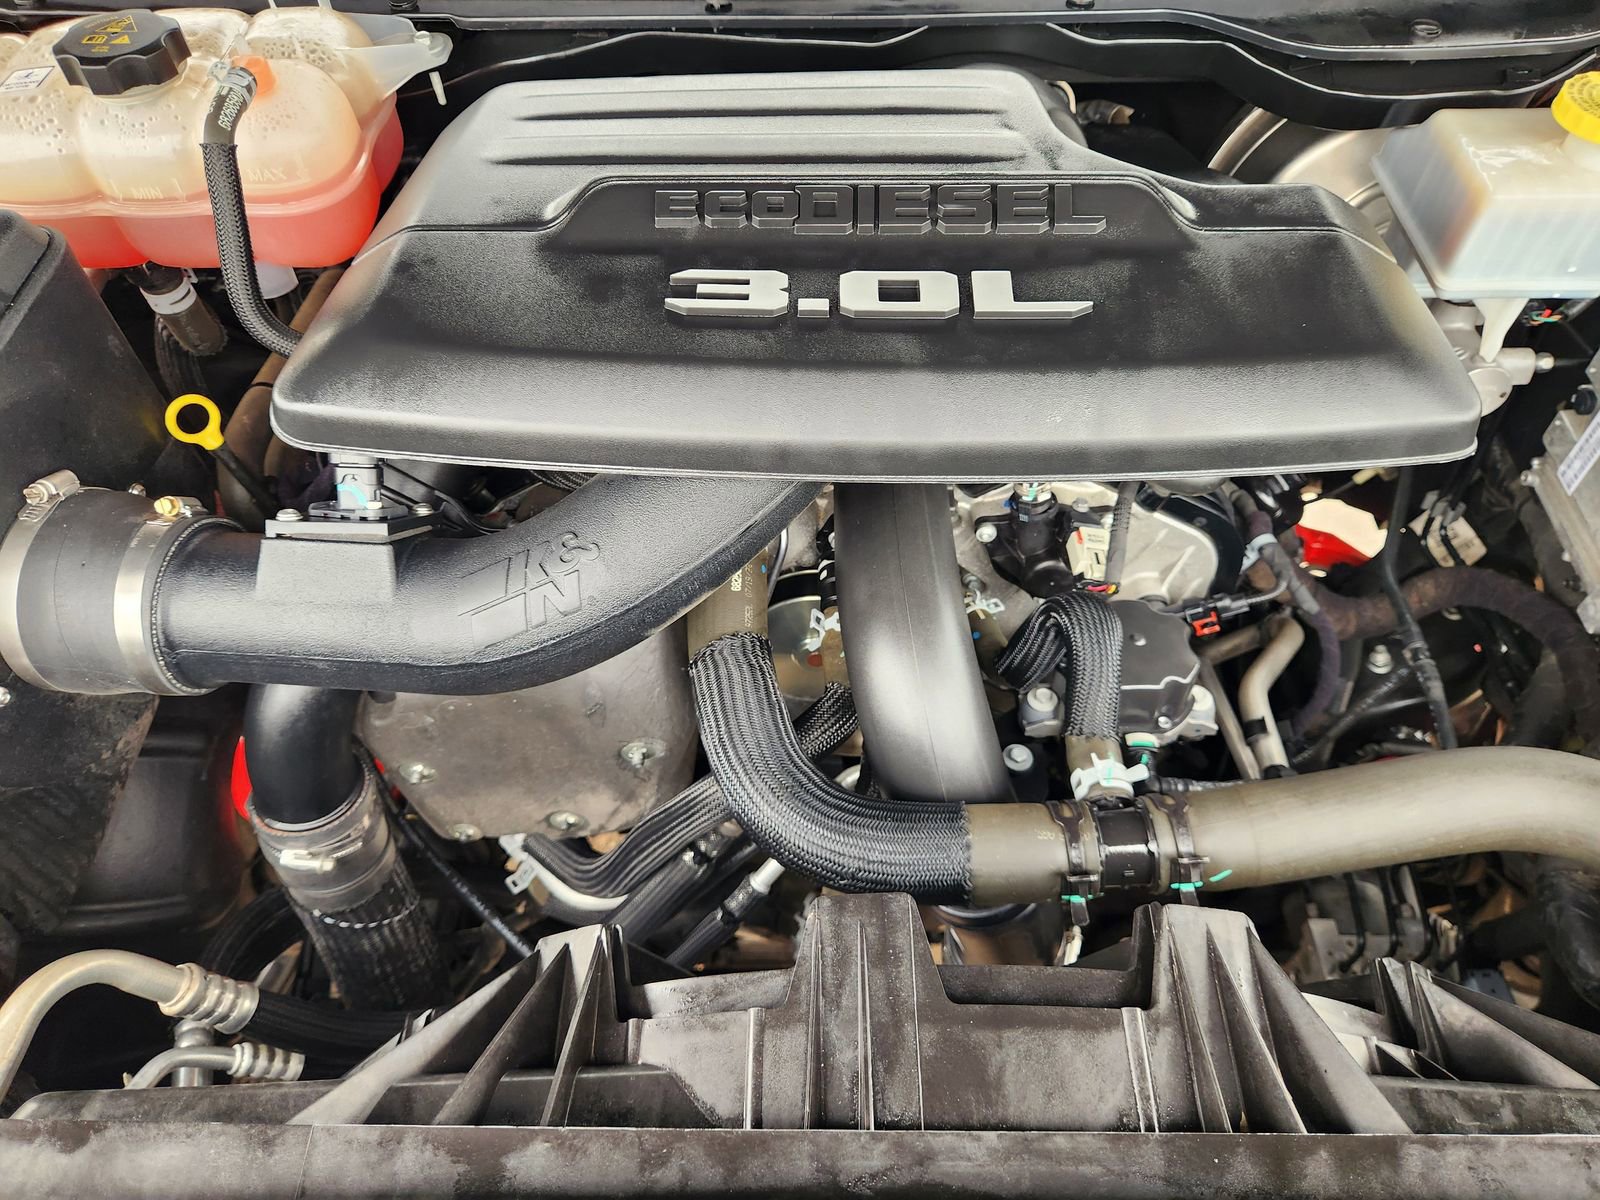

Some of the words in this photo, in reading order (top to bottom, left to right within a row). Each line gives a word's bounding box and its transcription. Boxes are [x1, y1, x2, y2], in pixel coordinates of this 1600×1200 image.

[247, 168, 287, 182] MAX
[131, 187, 164, 200] MIN
[655, 184, 1107, 235] ECODIESEL
[664, 268, 1094, 319] 3.0L
